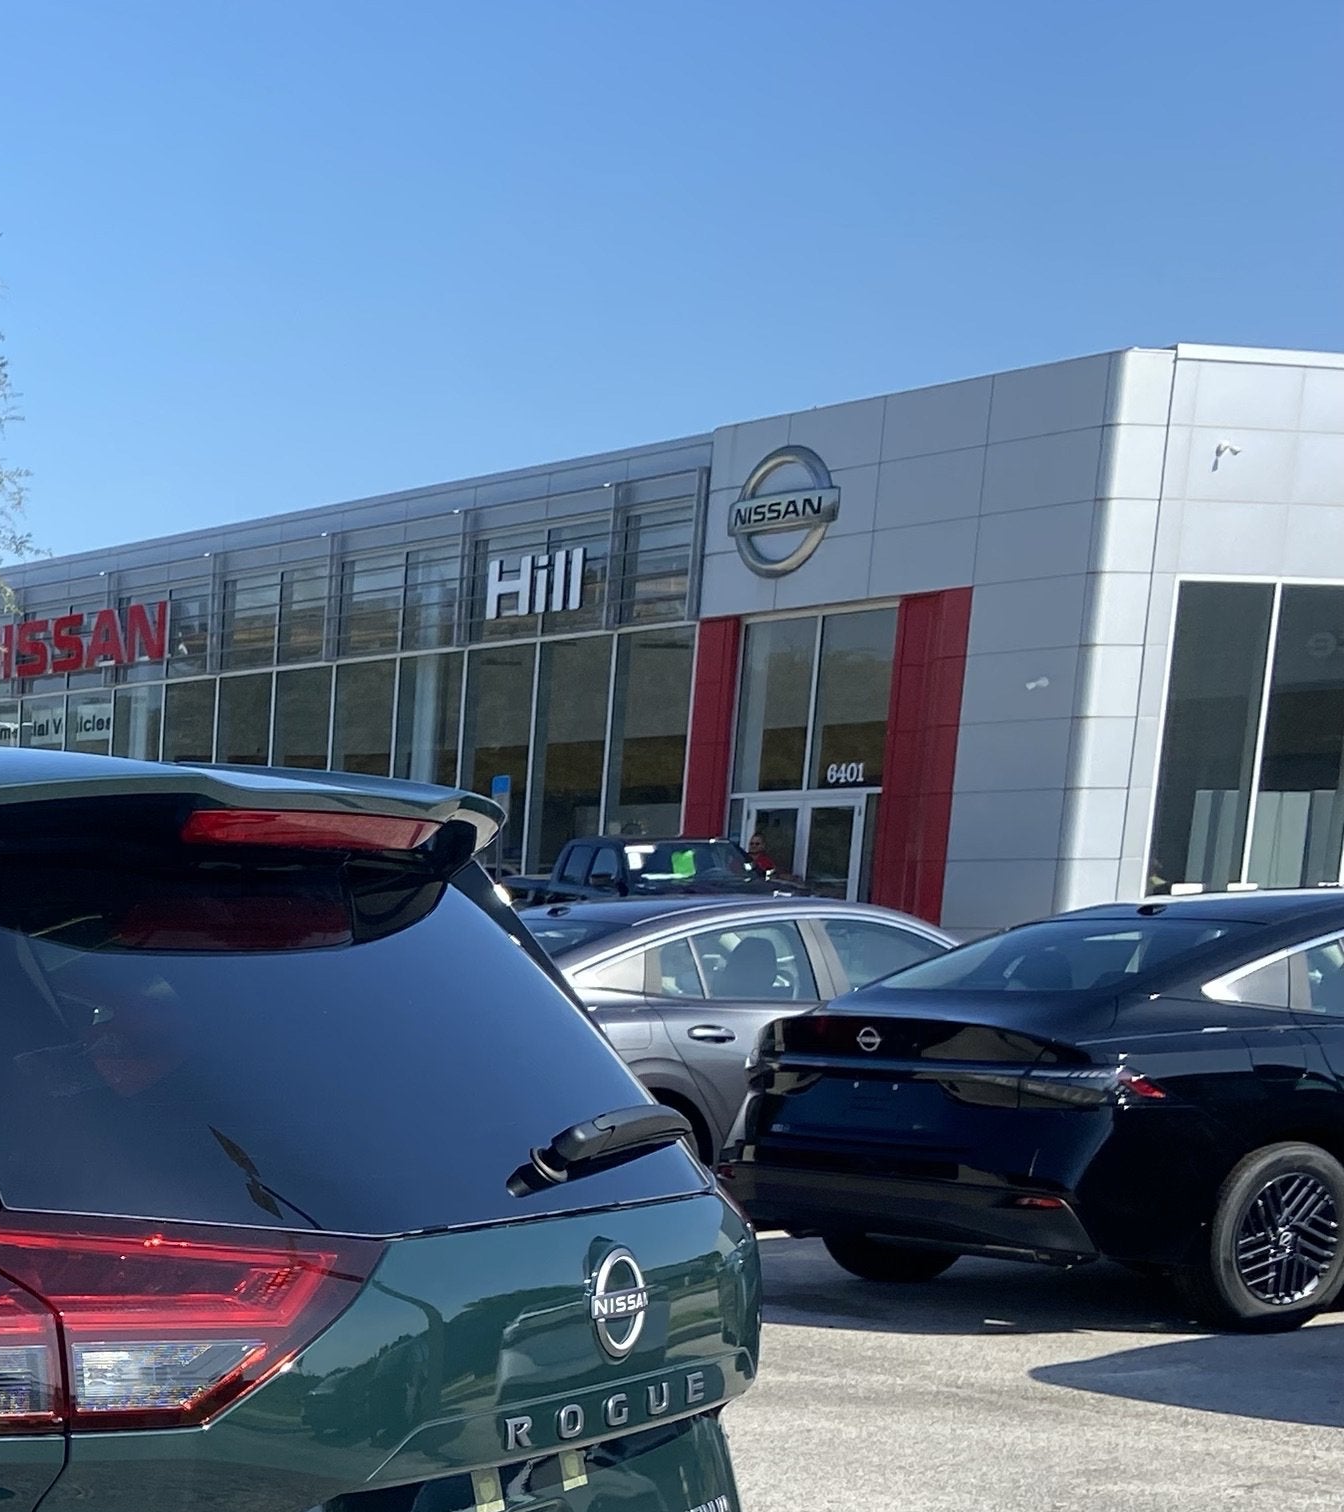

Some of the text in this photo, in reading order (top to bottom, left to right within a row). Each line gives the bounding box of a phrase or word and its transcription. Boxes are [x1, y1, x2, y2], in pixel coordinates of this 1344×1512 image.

[733, 495, 824, 527] NISSAN
[485, 546, 587, 621] Hill
[827, 762, 865, 784] 6401
[593, 1289, 649, 1318] NISSAN
[504, 1371, 706, 1452] ROGUE
